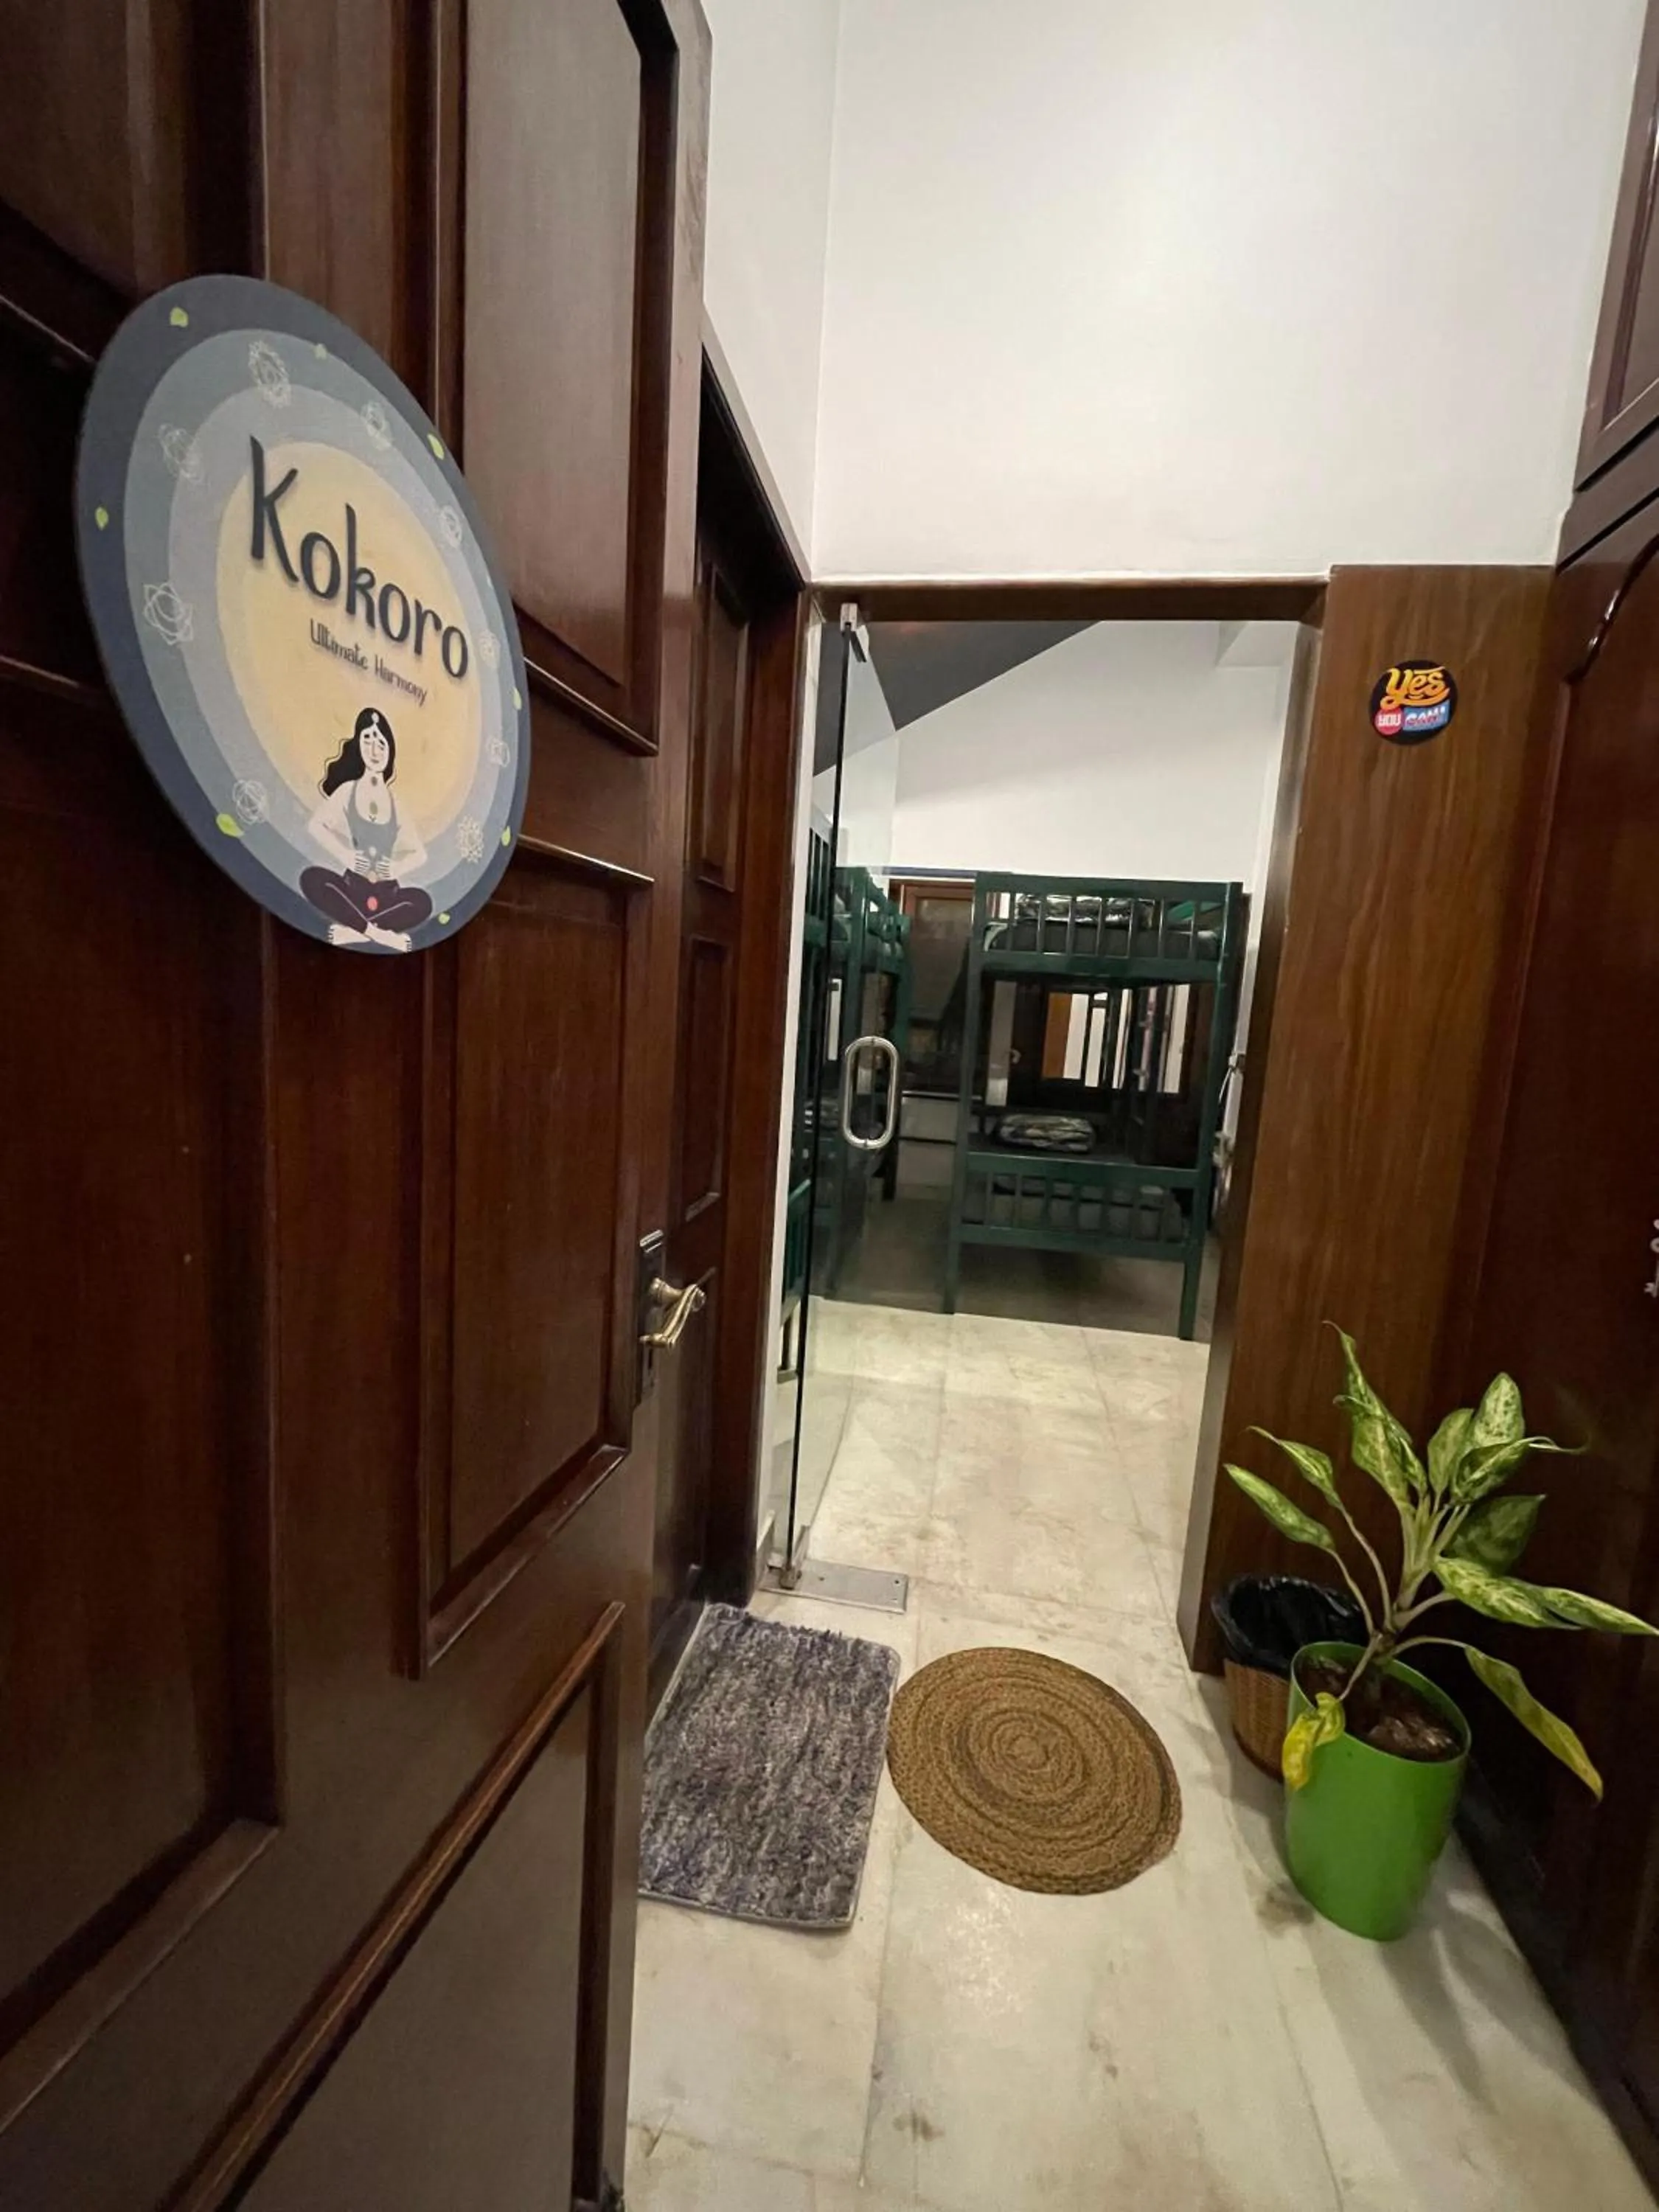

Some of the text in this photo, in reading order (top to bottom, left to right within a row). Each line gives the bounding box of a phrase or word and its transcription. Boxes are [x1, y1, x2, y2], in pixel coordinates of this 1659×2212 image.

[249, 434, 468, 678] Kokoro
[310, 618, 428, 707] Ultimate Harmony
